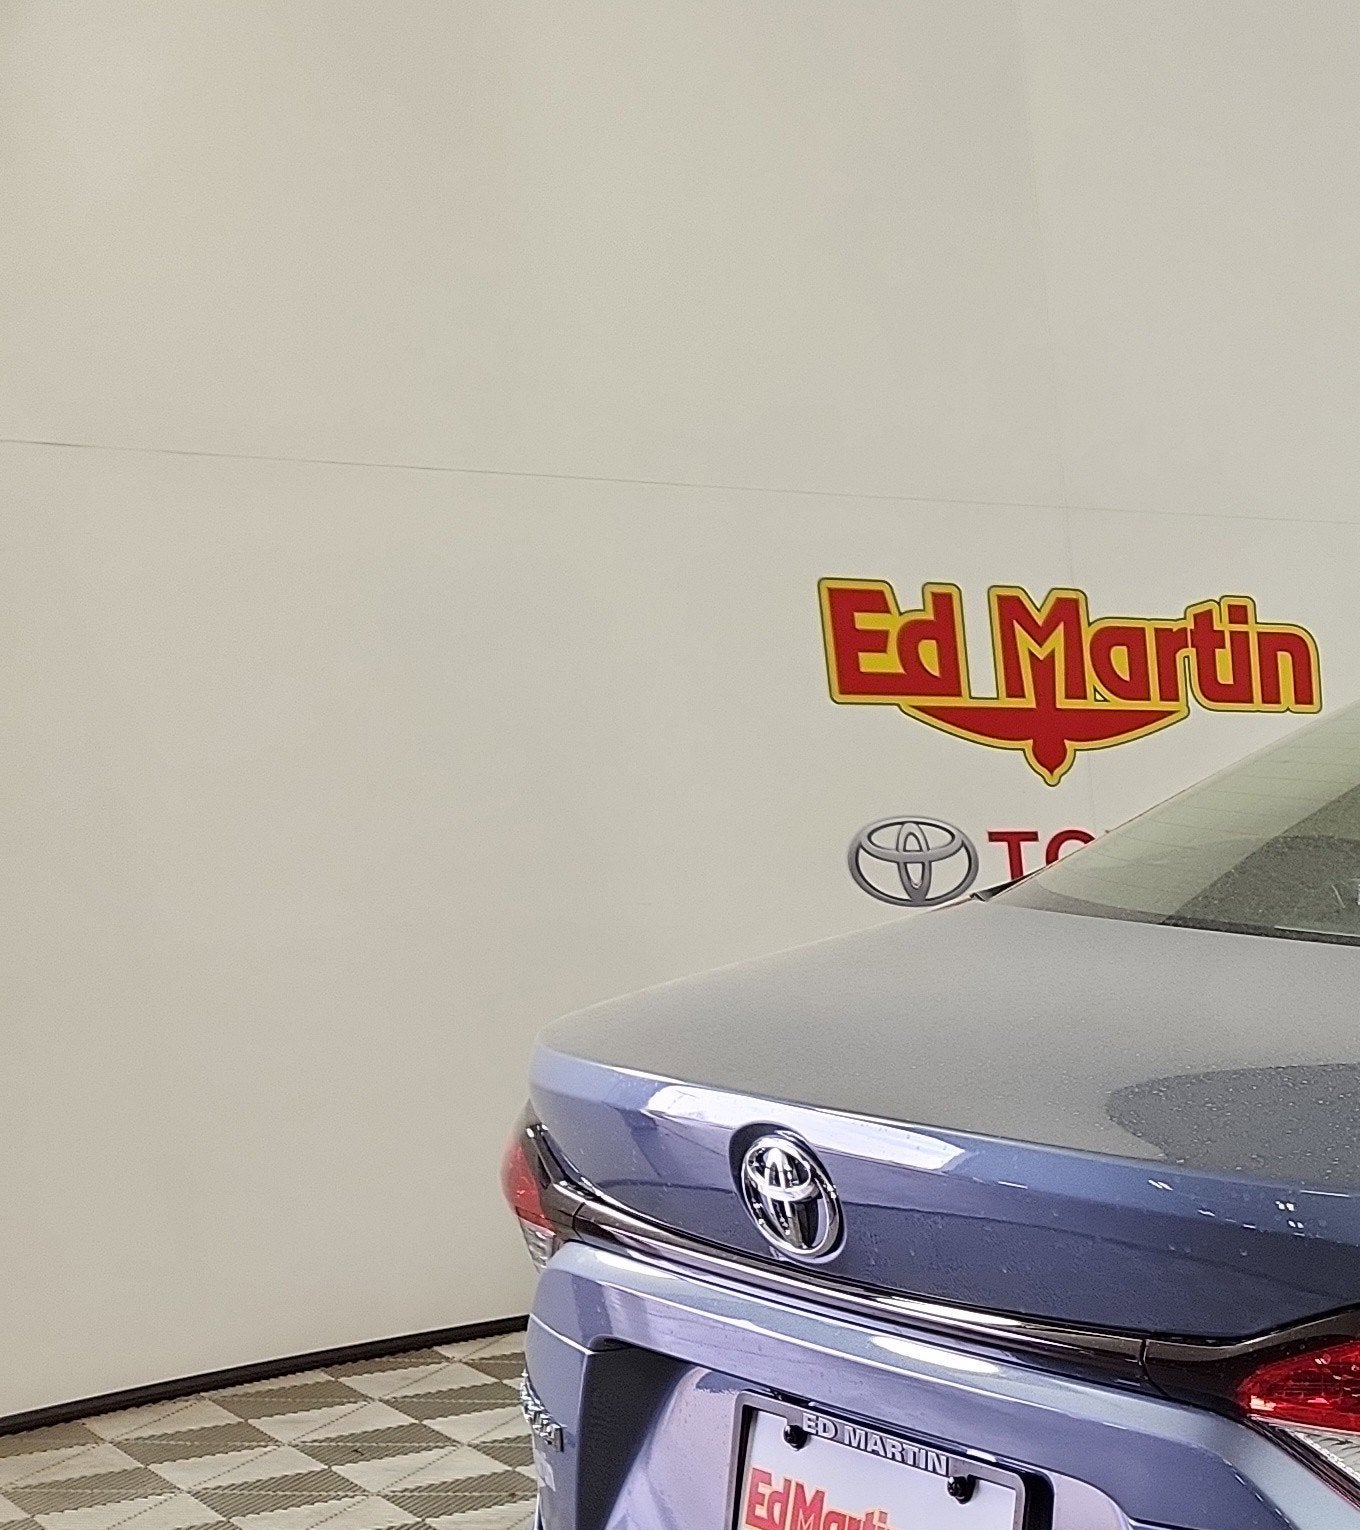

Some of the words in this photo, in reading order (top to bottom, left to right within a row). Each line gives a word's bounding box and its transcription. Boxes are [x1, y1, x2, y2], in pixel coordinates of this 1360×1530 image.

[819, 578, 968, 702] Ed
[988, 586, 1321, 712] Martin
[802, 1411, 838, 1440] ED
[844, 1425, 950, 1477] MARTIN
